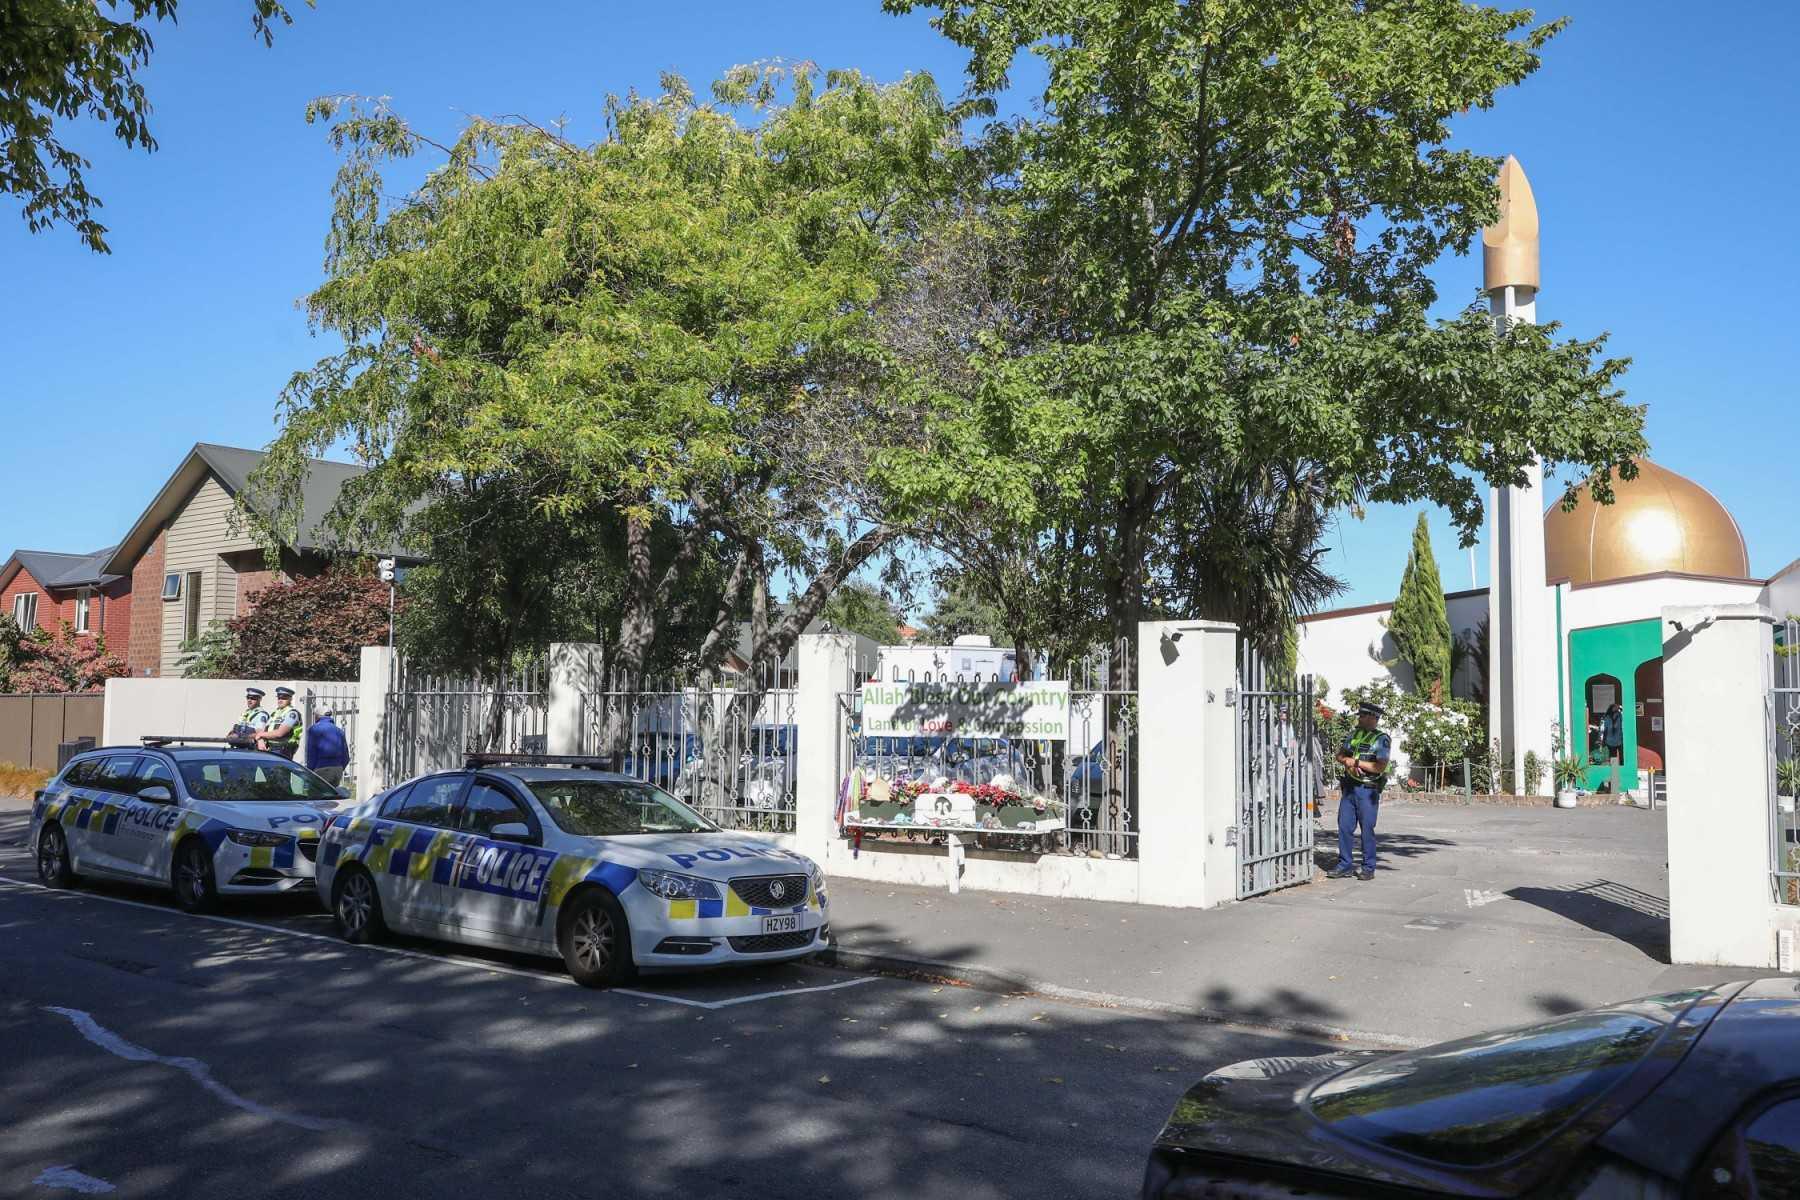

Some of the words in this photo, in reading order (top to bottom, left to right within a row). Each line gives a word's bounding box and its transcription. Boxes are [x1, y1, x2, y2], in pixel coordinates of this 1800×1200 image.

[863, 687, 904, 705] Allah
[911, 687, 951, 705] Bless
[958, 688, 991, 705] Our
[995, 688, 1067, 711] Country
[868, 717, 900, 731] Land
[920, 718, 953, 732] Love
[974, 718, 1063, 735] Compassion
[125, 804, 179, 832] POLICE
[267, 814, 324, 829] PO
[463, 845, 551, 894] POLICE
[666, 846, 803, 870] POLICE
[766, 917, 796, 932] HZY98
